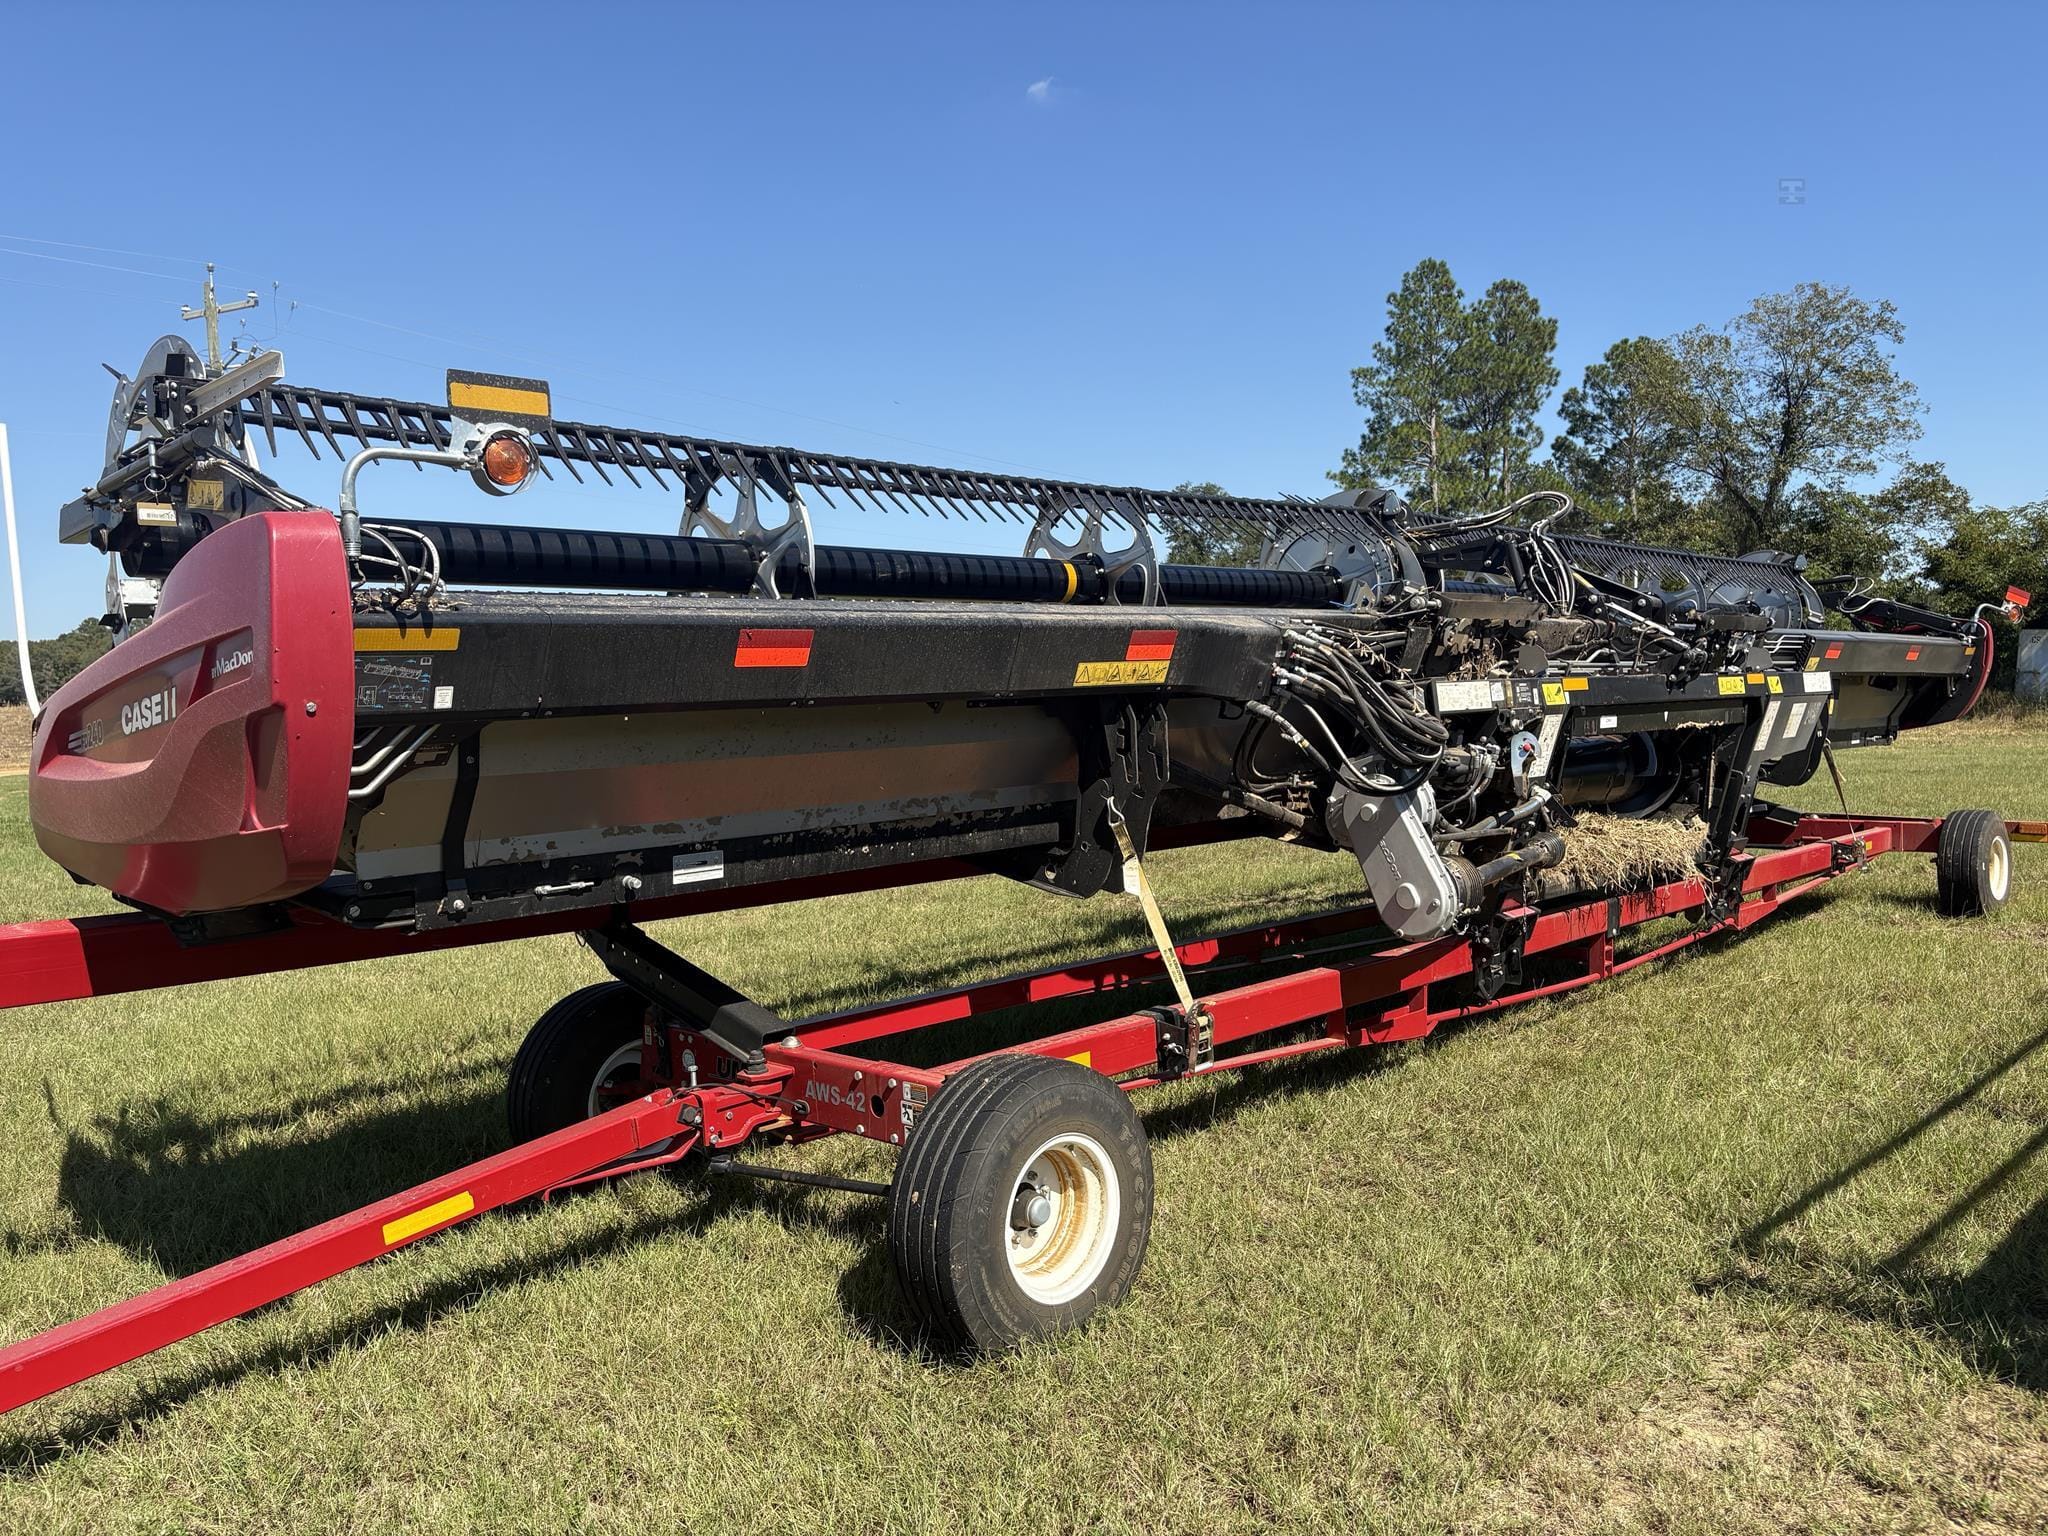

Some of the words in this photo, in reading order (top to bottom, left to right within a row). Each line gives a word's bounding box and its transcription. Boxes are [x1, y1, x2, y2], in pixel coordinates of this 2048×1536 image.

[216, 649, 254, 678] MacDon
[121, 692, 162, 735] CASE
[805, 1079, 867, 1114] AWS-42
